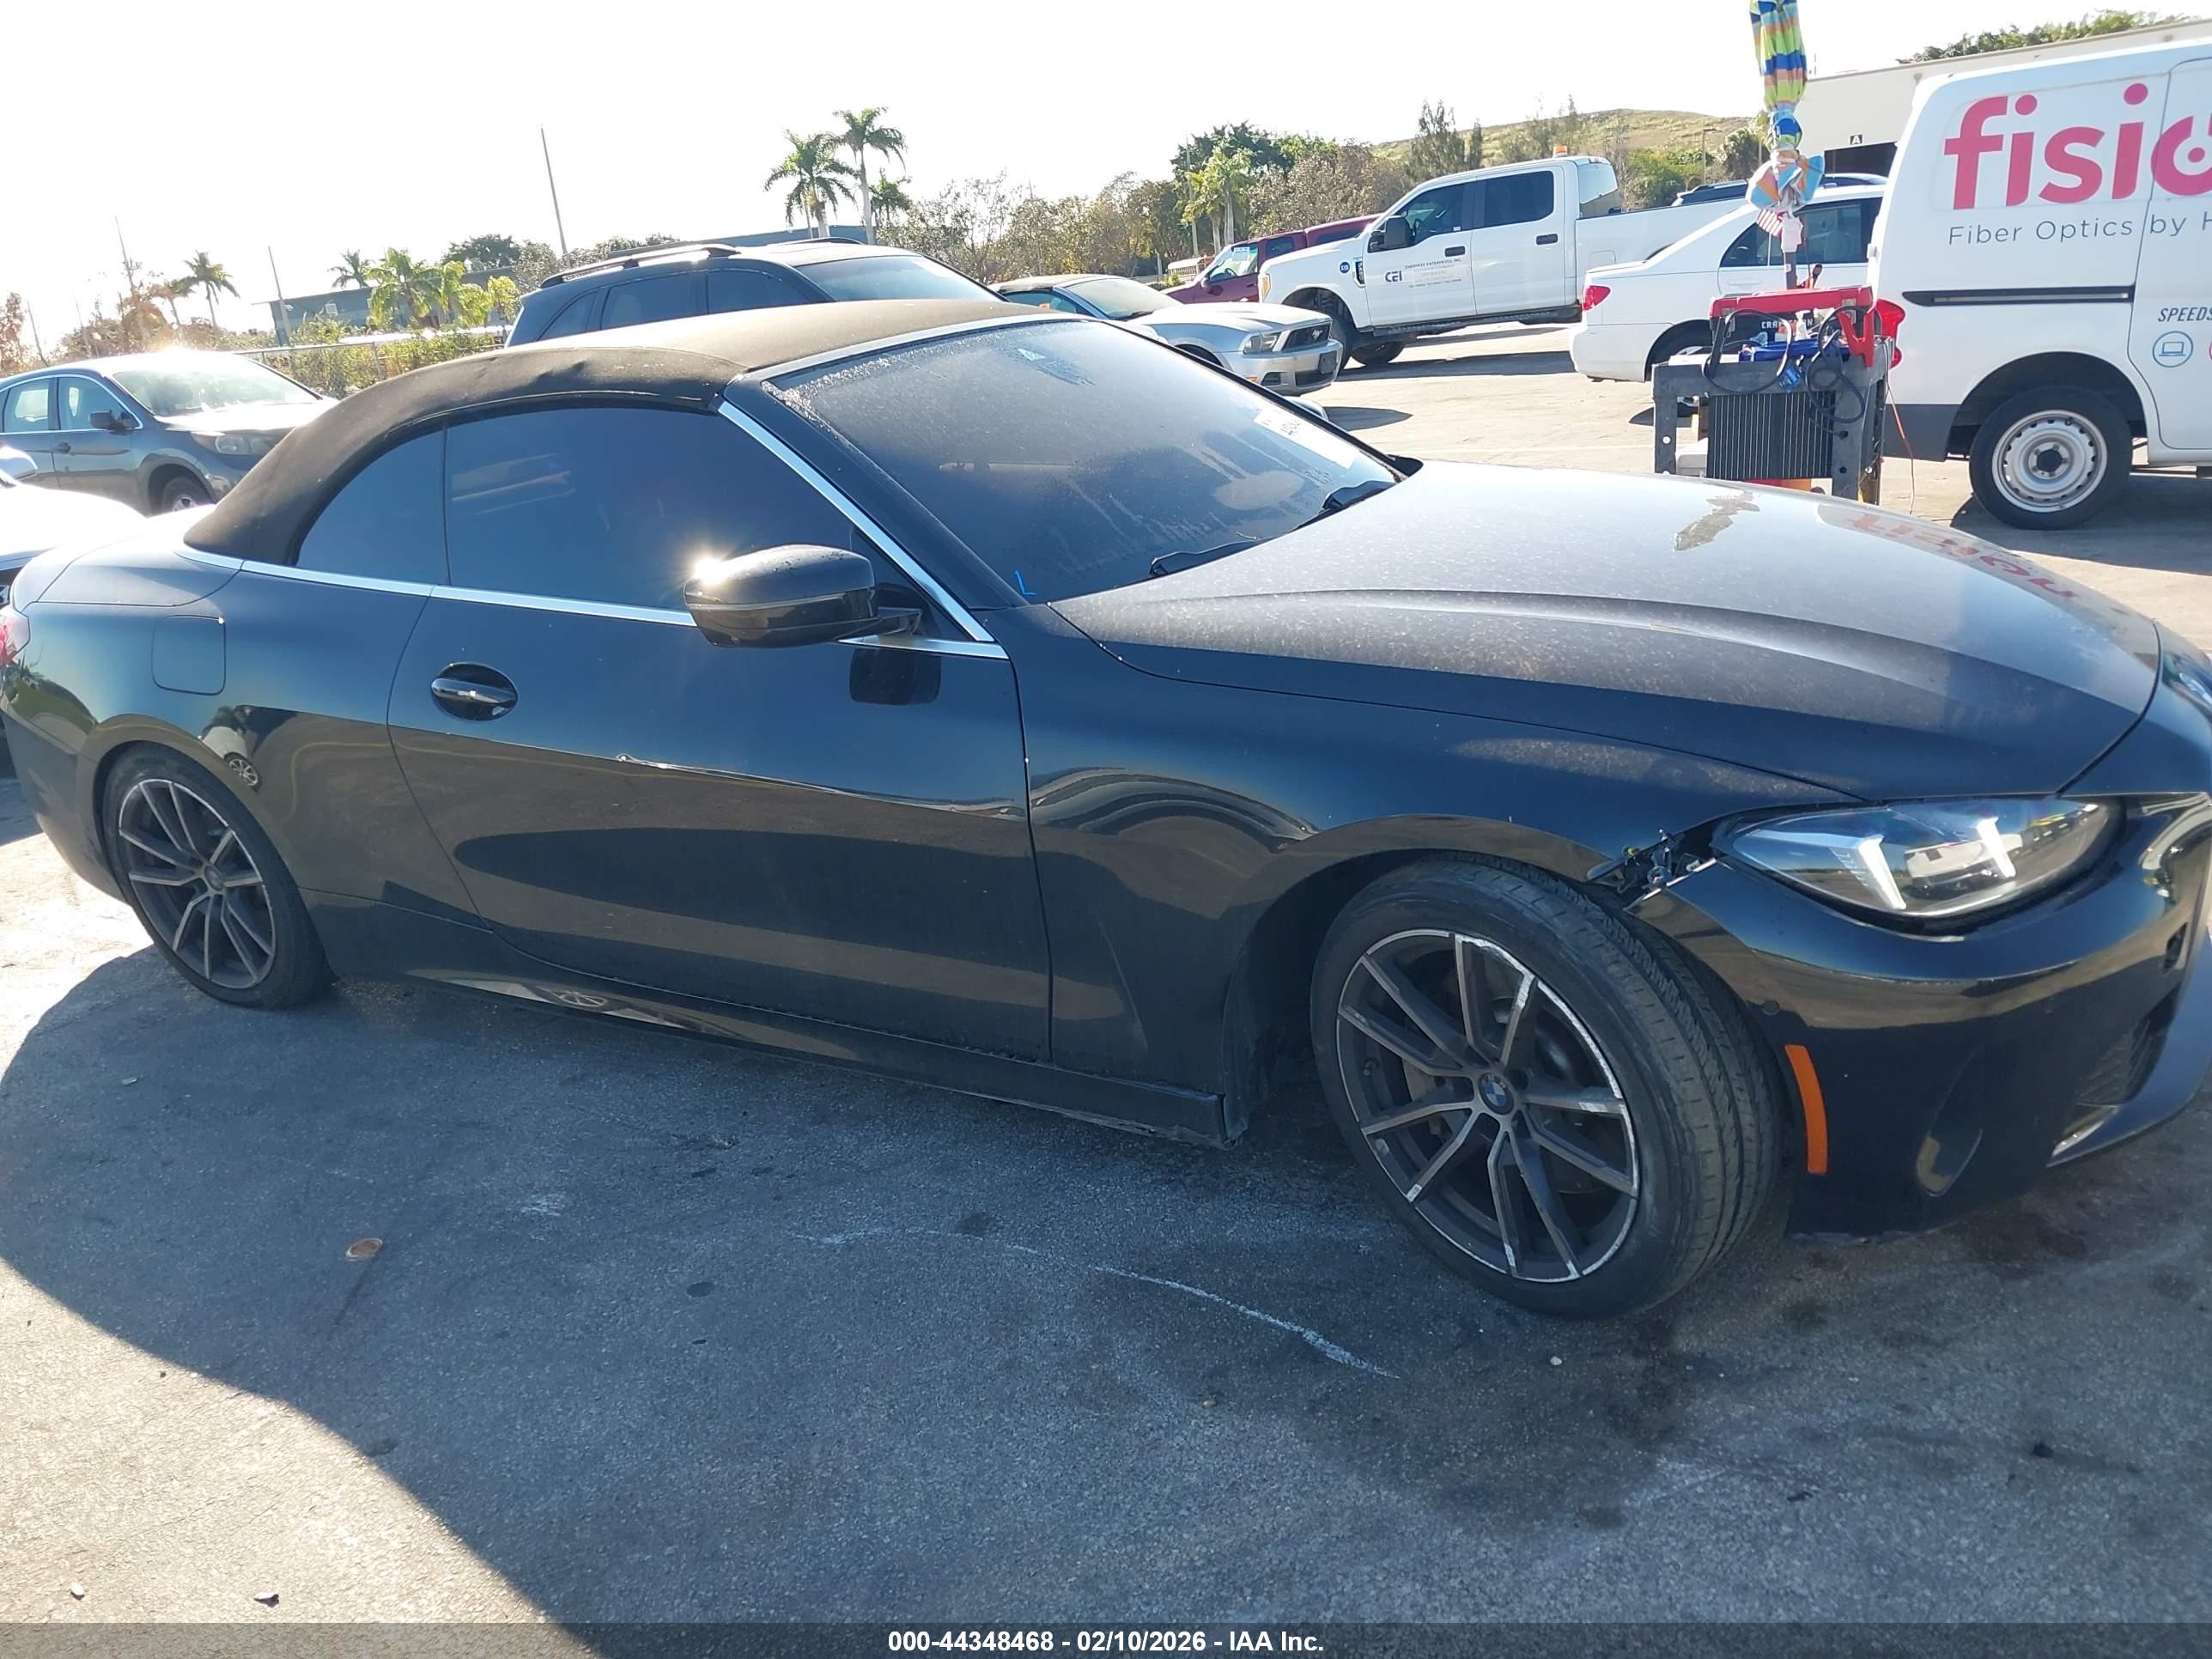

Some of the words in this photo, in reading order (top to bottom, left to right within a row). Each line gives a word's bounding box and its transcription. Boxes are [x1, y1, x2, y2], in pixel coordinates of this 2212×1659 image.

[1851, 135, 1861, 144] A
[1948, 223, 2022, 246] Fiber
[2036, 218, 2133, 243] Optics
[2149, 213, 2187, 237] by
[1384, 270, 1403, 283] CEI
